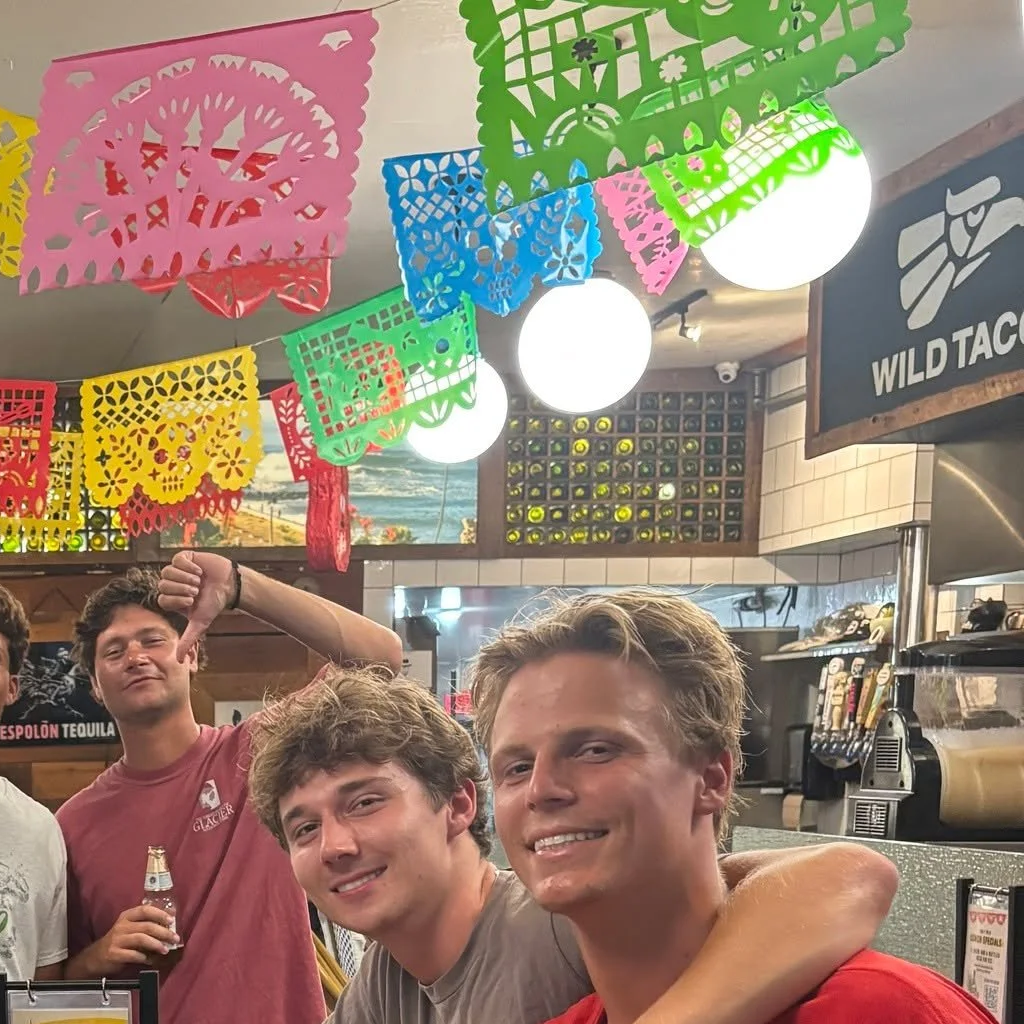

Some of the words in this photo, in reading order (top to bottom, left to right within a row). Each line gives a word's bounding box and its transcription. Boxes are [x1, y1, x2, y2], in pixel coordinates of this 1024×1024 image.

[872, 337, 948, 397] WILD
[952, 310, 1024, 370] TAC
[62, 721, 116, 739] TEQUILA
[192, 803, 235, 832] GLACIER
